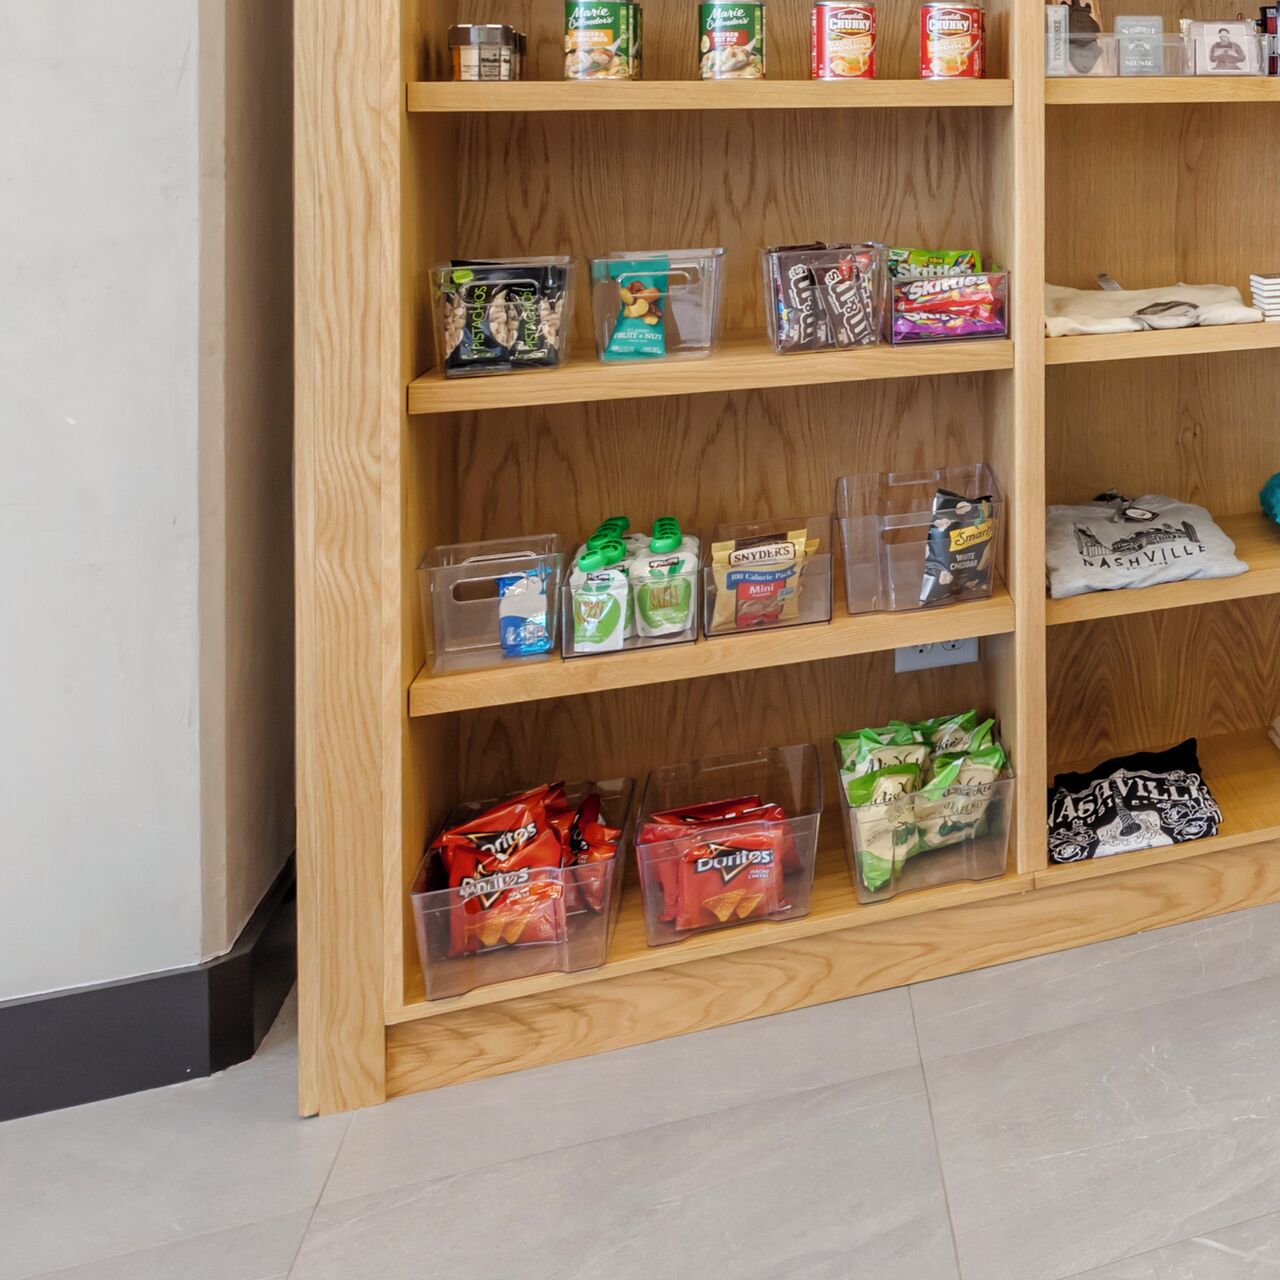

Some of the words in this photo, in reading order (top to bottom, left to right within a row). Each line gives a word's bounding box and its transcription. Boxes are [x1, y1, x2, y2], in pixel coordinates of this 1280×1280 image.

[569, 7, 610, 20] Marie
[707, 8, 746, 20] Marie
[829, 18, 871, 29] CHUNKY
[929, 19, 969, 30] CHUNKY
[908, 276, 988, 300] Skittles
[472, 286, 487, 350] PISTACHIOS
[734, 546, 790, 563] SNYDER'S
[956, 552, 976, 561] WHITE
[1082, 545, 1207, 569] NASHVILLE
[950, 560, 978, 571] CHEDDAR
[731, 573, 744, 581] 100
[745, 573, 773, 581] Calorie
[775, 569, 792, 579] Pack
[749, 584, 774, 594] Mini
[697, 850, 772, 872] Doritos
